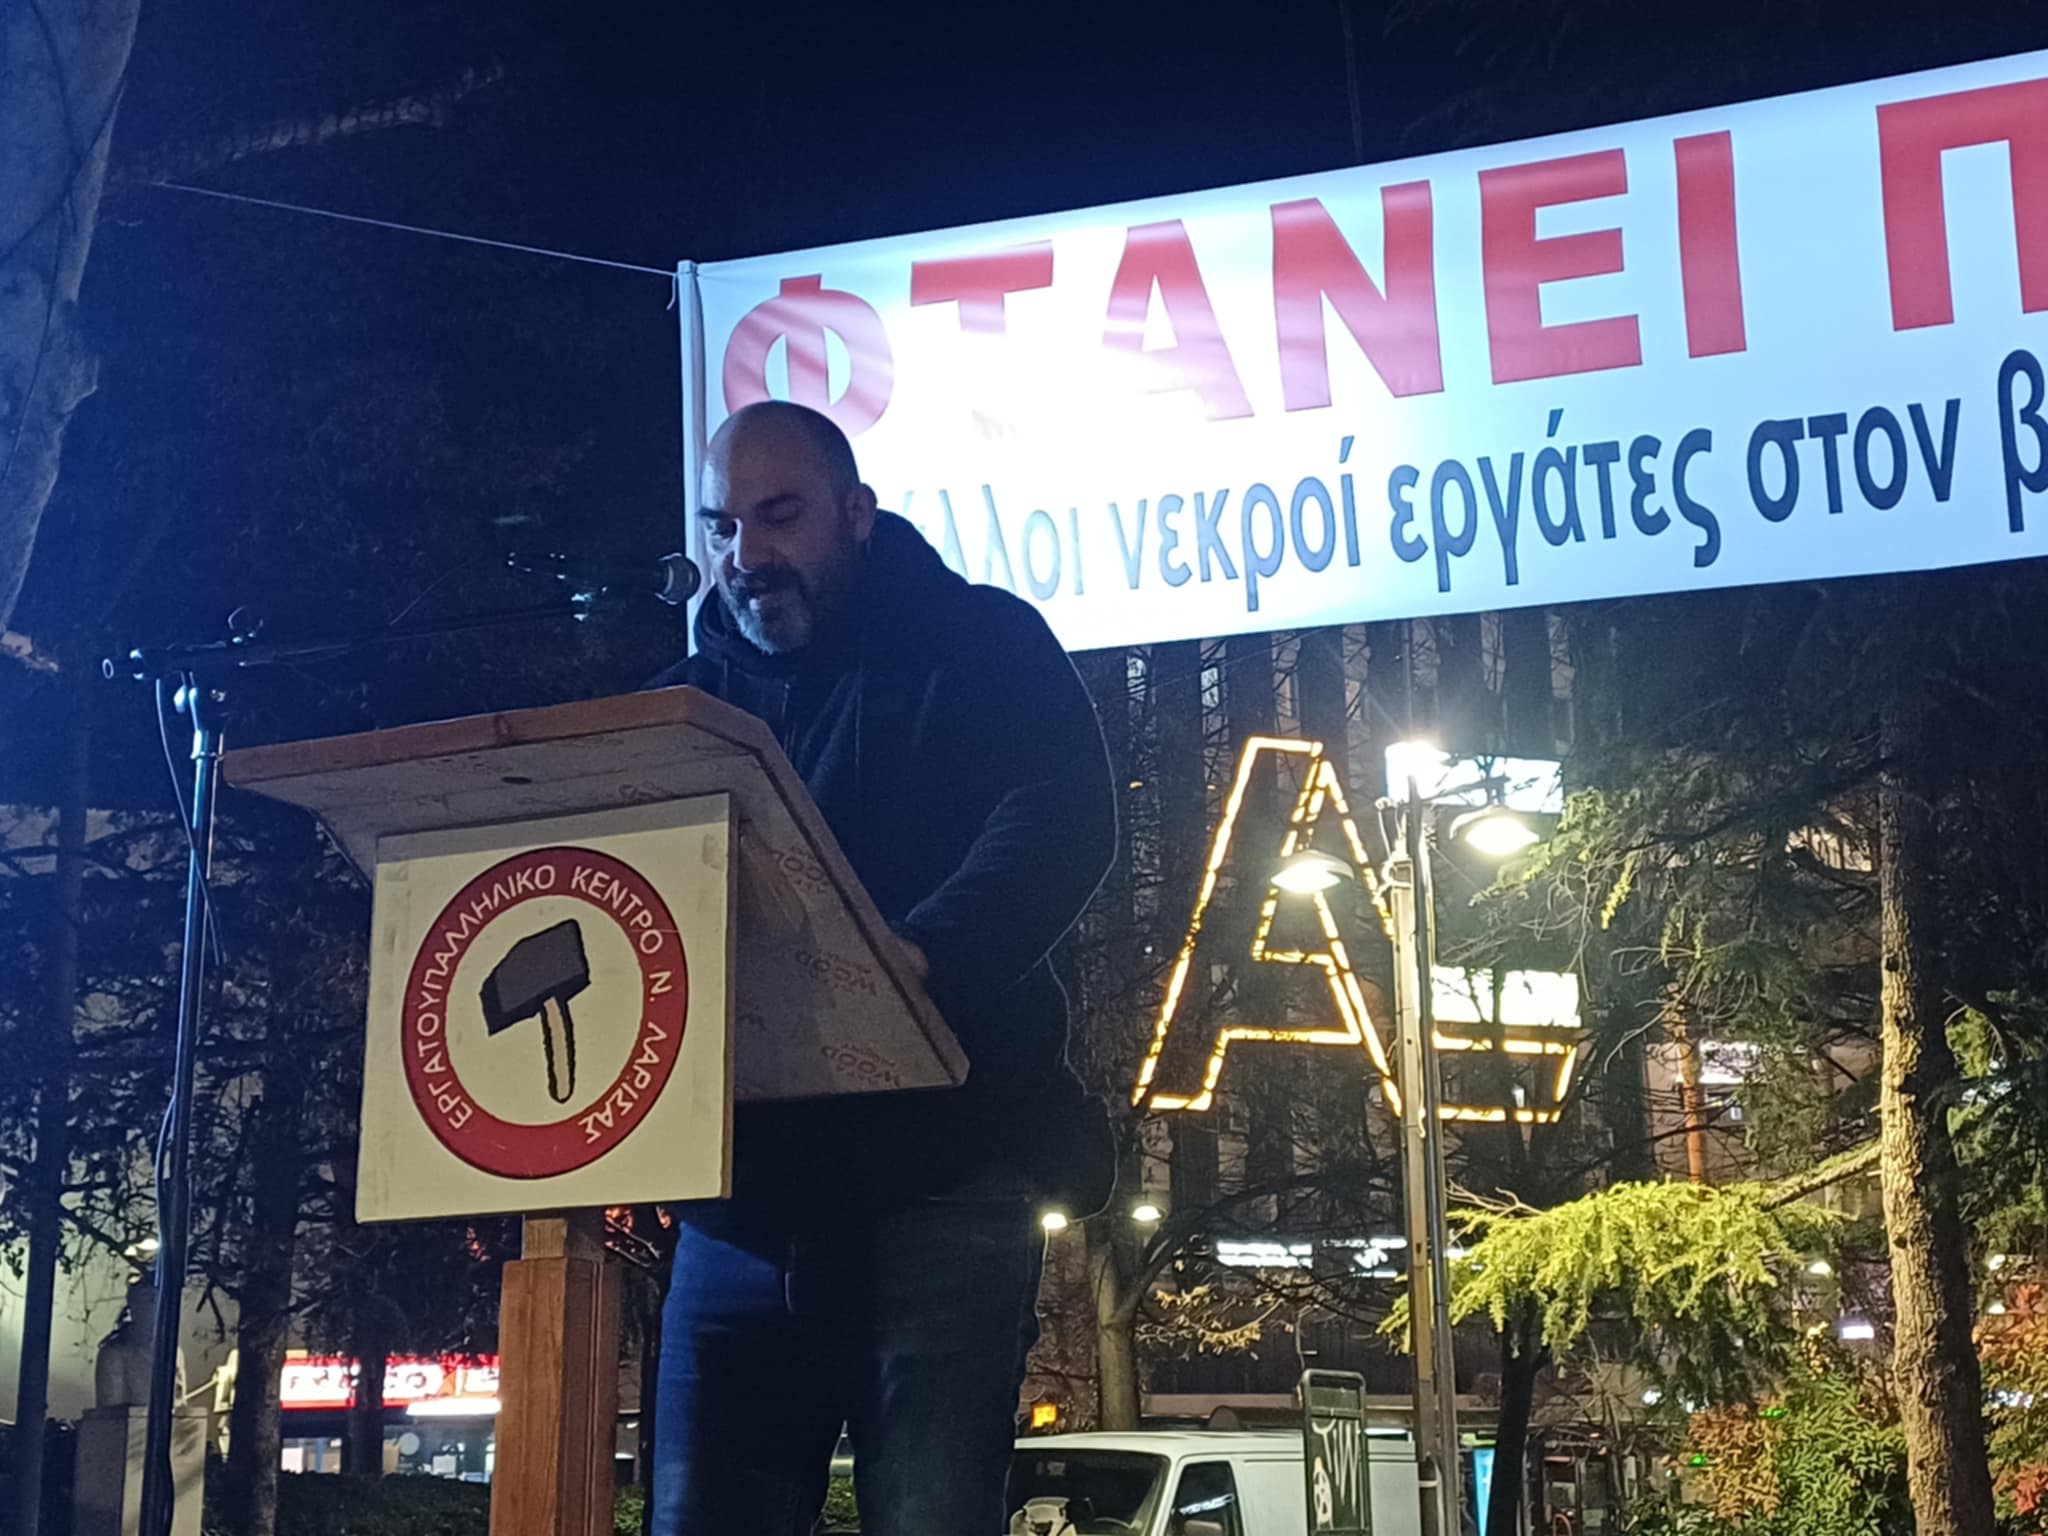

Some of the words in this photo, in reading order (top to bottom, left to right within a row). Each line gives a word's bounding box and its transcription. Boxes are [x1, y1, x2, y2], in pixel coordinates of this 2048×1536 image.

[902, 484, 1084, 601] λλοι
[1108, 436, 1361, 612] νεκροί
[1388, 408, 1721, 593] εργάτες
[1746, 398, 1962, 523] στον
[571, 865, 664, 954] ΚΕΝΤΡΟ
[417, 864, 556, 1130] ΕΡΓΑΤΟΥΠΑΛΛΗΛΙΚΟ
[577, 1021, 668, 1145] ΛΑΡΙΣΑΣ
